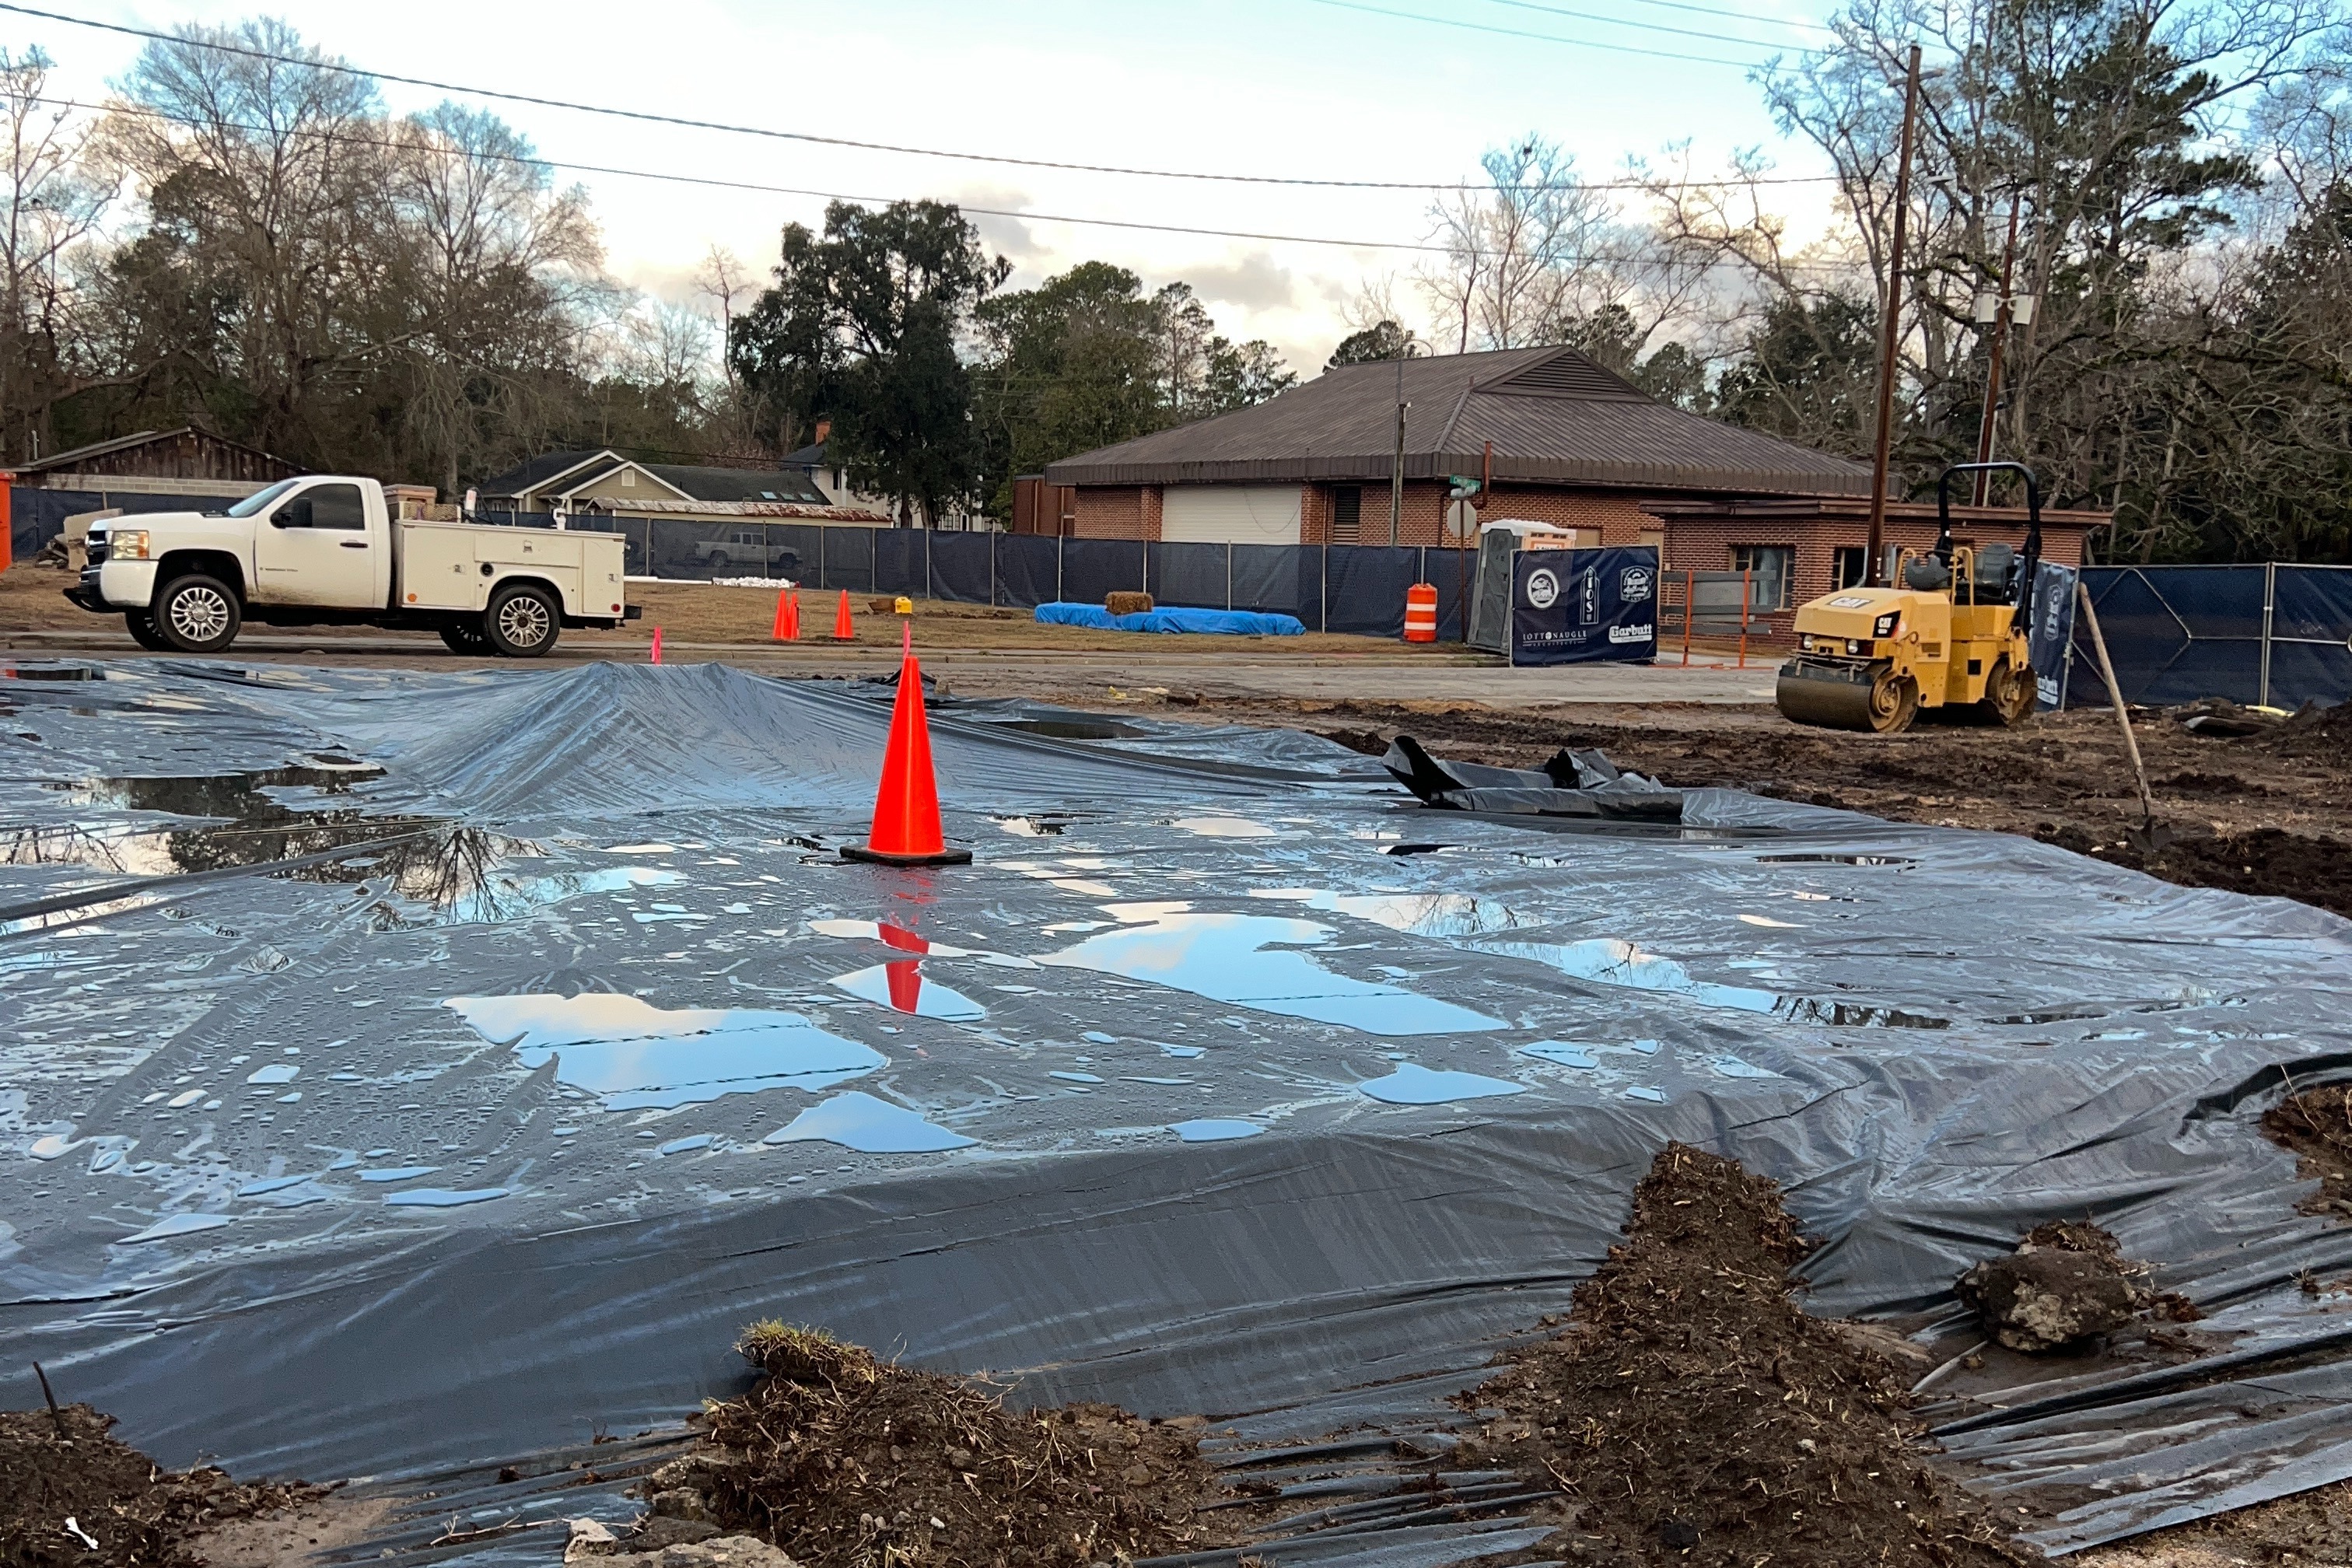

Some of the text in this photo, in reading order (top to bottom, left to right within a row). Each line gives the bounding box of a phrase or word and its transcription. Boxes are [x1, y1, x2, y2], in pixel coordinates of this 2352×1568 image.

[1829, 597, 1871, 608] CAT
[1878, 617, 1892, 628] CAT
[1609, 624, 1652, 637] Garbutt
